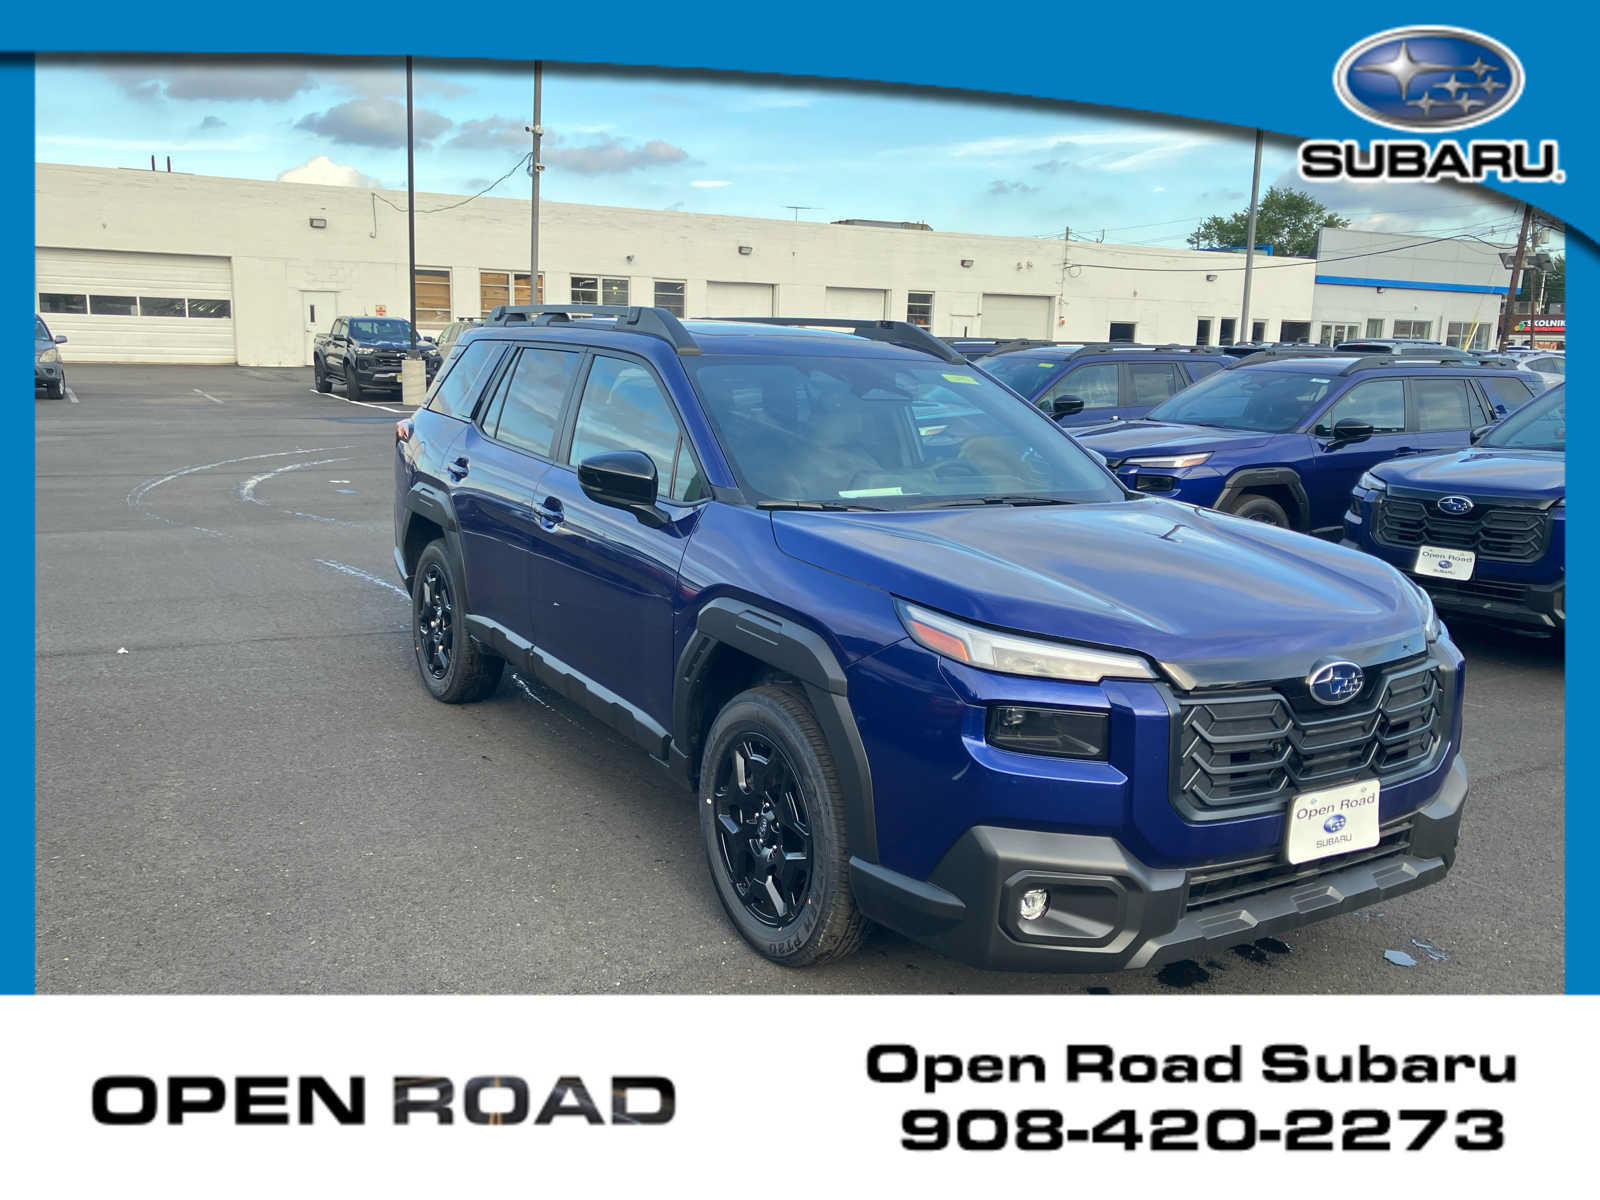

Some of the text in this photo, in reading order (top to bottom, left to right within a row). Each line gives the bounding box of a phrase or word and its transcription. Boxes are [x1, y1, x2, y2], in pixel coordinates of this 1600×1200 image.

[1296, 793, 1375, 820] Open Road
[1316, 833, 1352, 848] SUBARU
